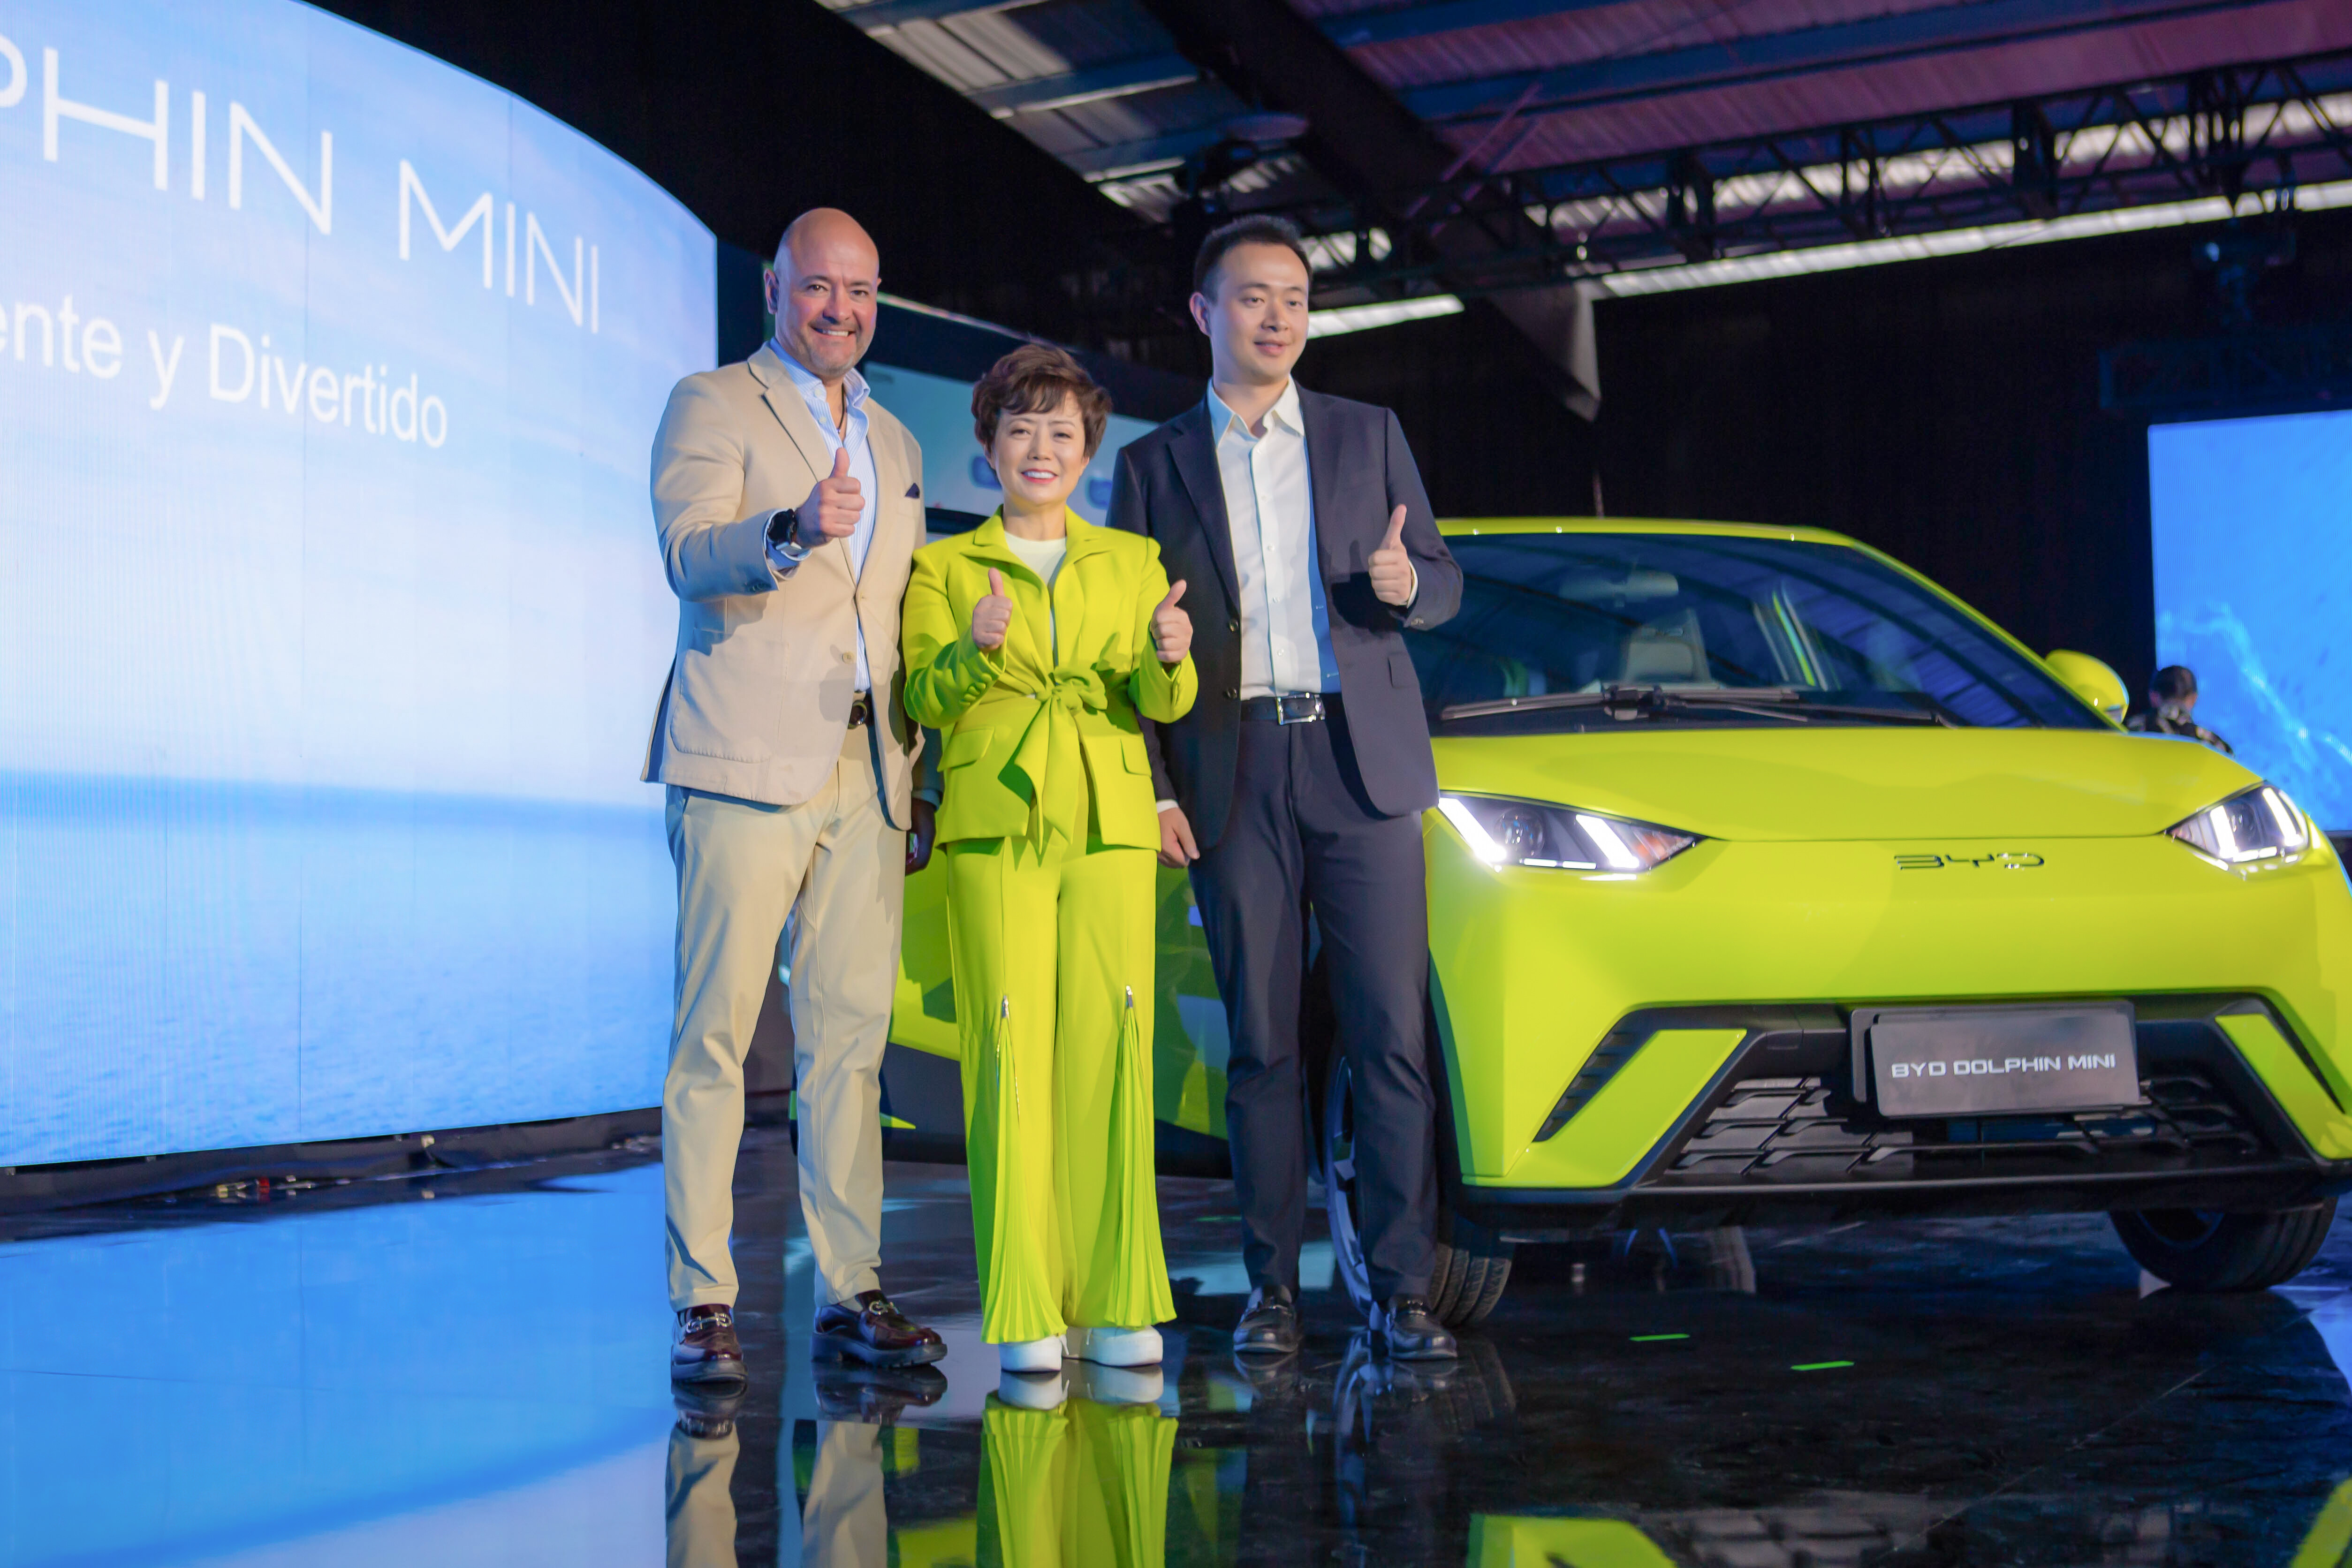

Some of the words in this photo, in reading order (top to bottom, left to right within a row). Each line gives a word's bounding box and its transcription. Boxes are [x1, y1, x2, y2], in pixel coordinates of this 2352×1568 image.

[400, 159, 599, 334] MINI
[0, 294, 122, 379] nte
[148, 329, 183, 409] y
[209, 324, 448, 448] Divertido
[1894, 853, 2045, 870] BYD
[1891, 1060, 1946, 1078] BYD
[1953, 1057, 2061, 1075] DOLPHIN
[2068, 1053, 2116, 1070] MINI
